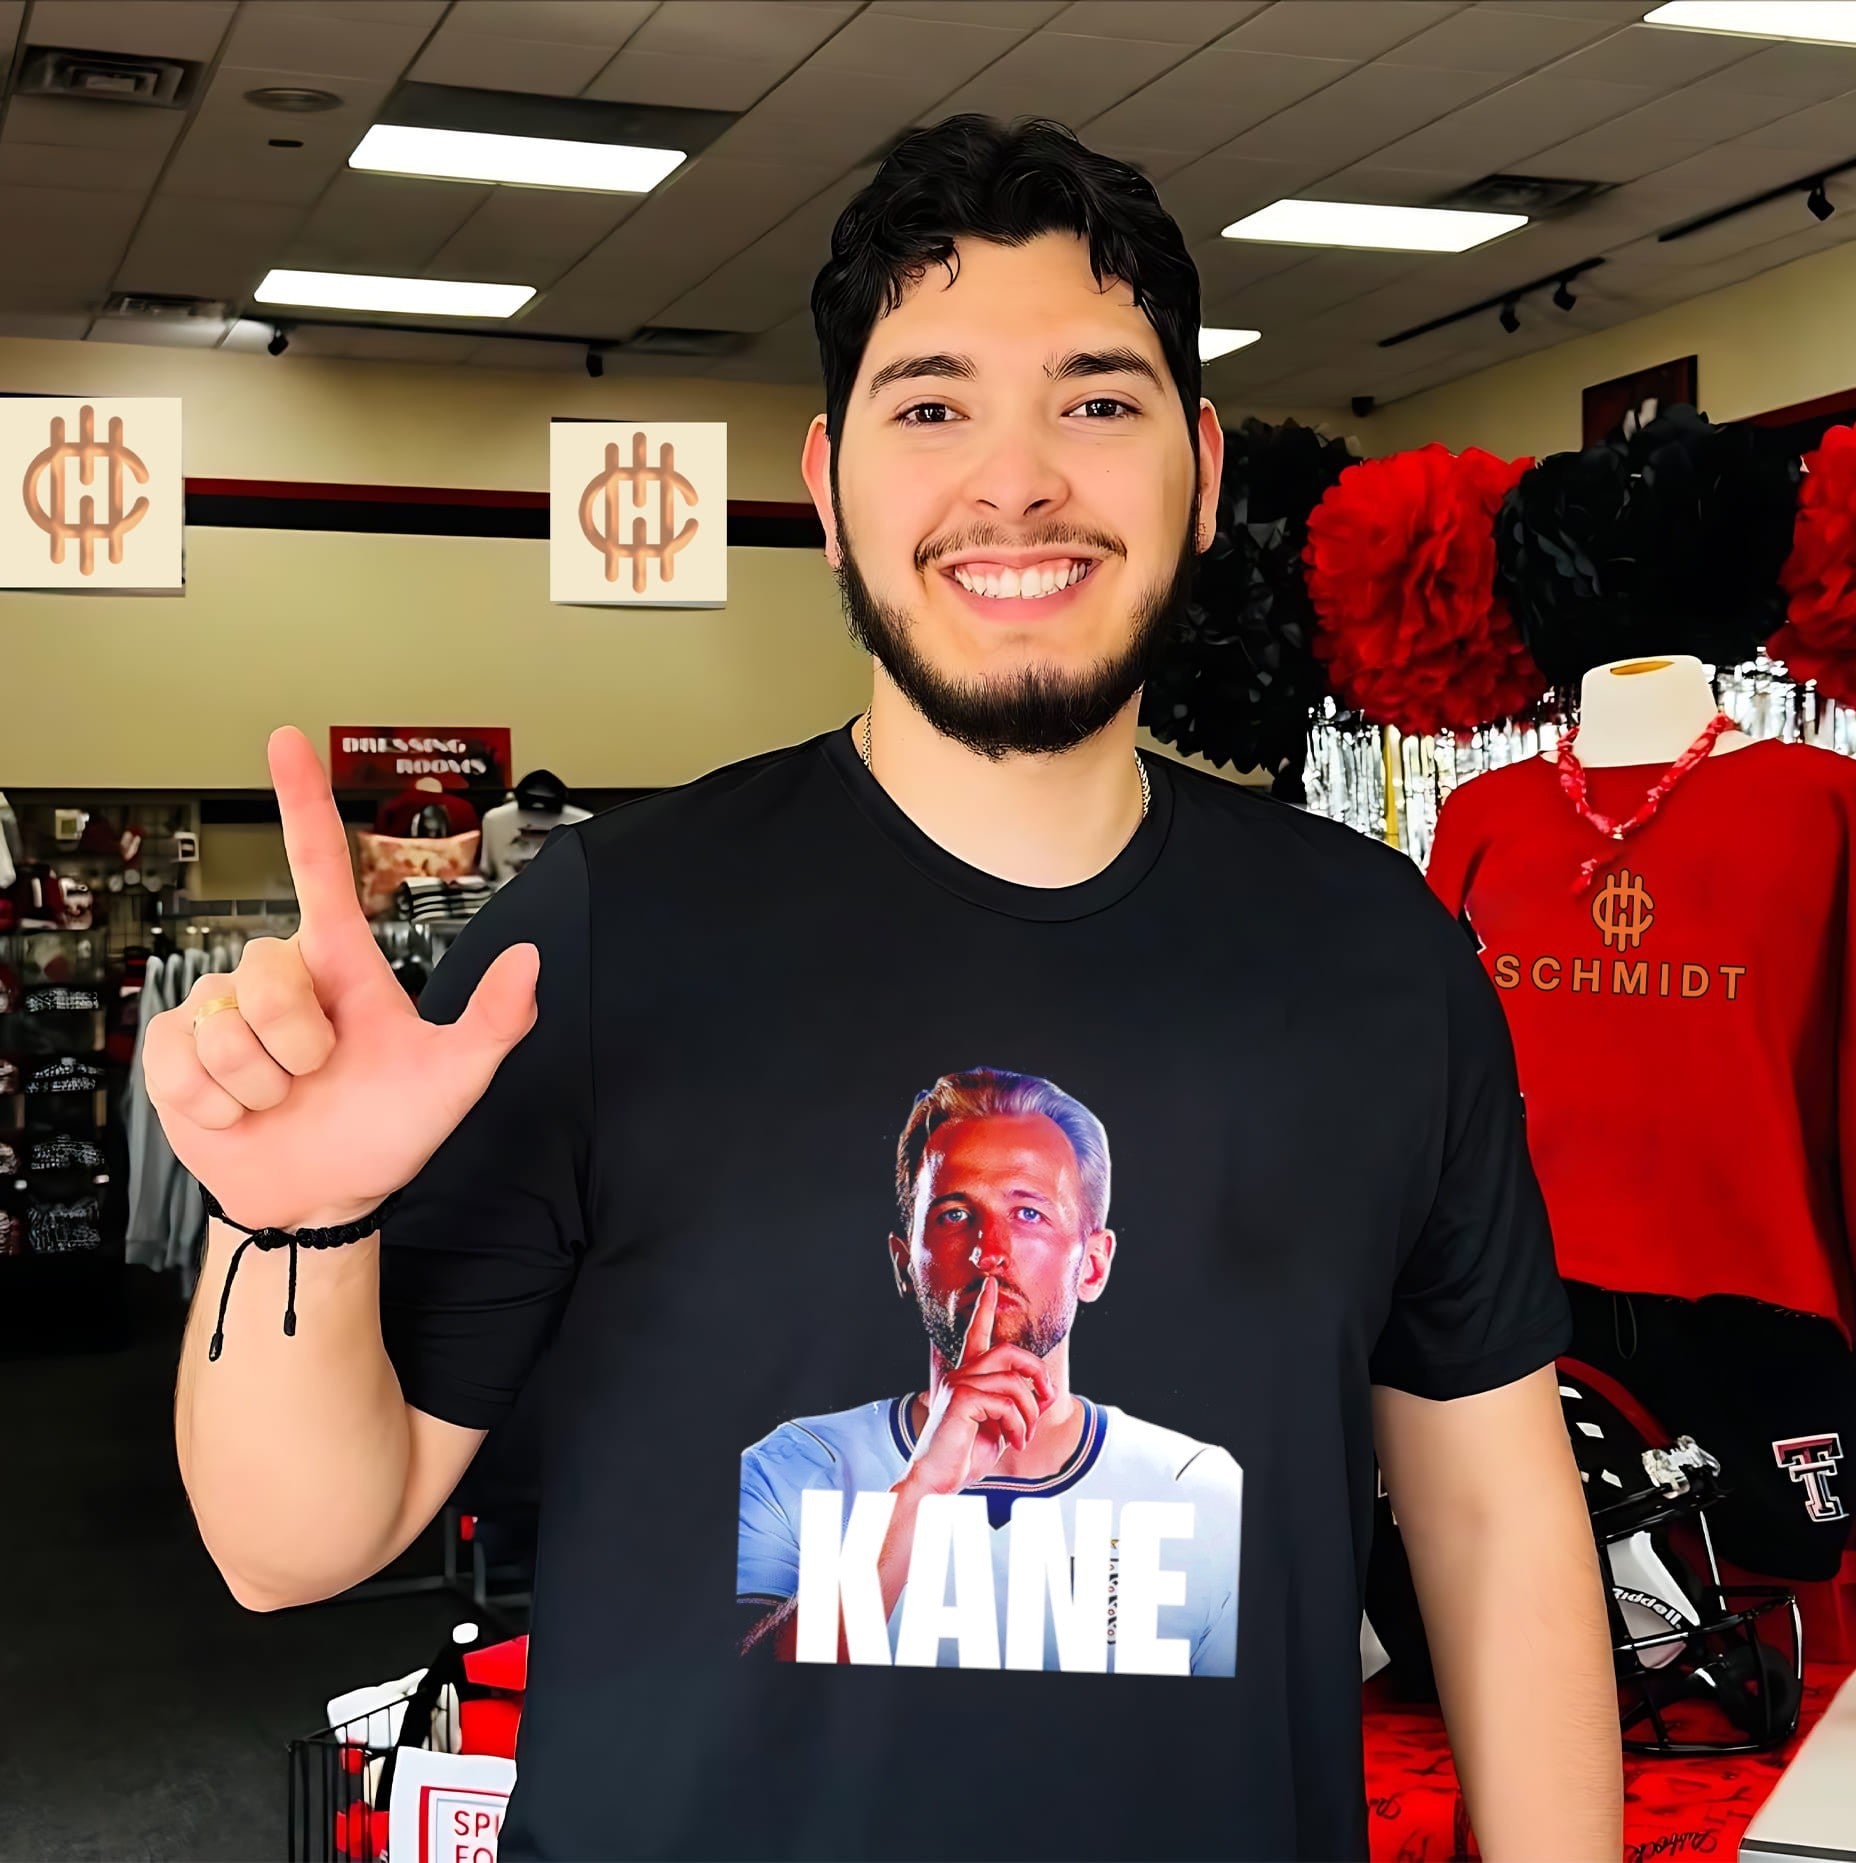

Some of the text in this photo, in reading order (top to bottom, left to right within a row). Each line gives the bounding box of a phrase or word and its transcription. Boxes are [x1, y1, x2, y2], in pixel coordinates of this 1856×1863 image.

[396, 758, 487, 775] ROOMS
[1494, 954, 1746, 1000] SCHMIDT
[796, 1489, 1196, 1676] KANE
